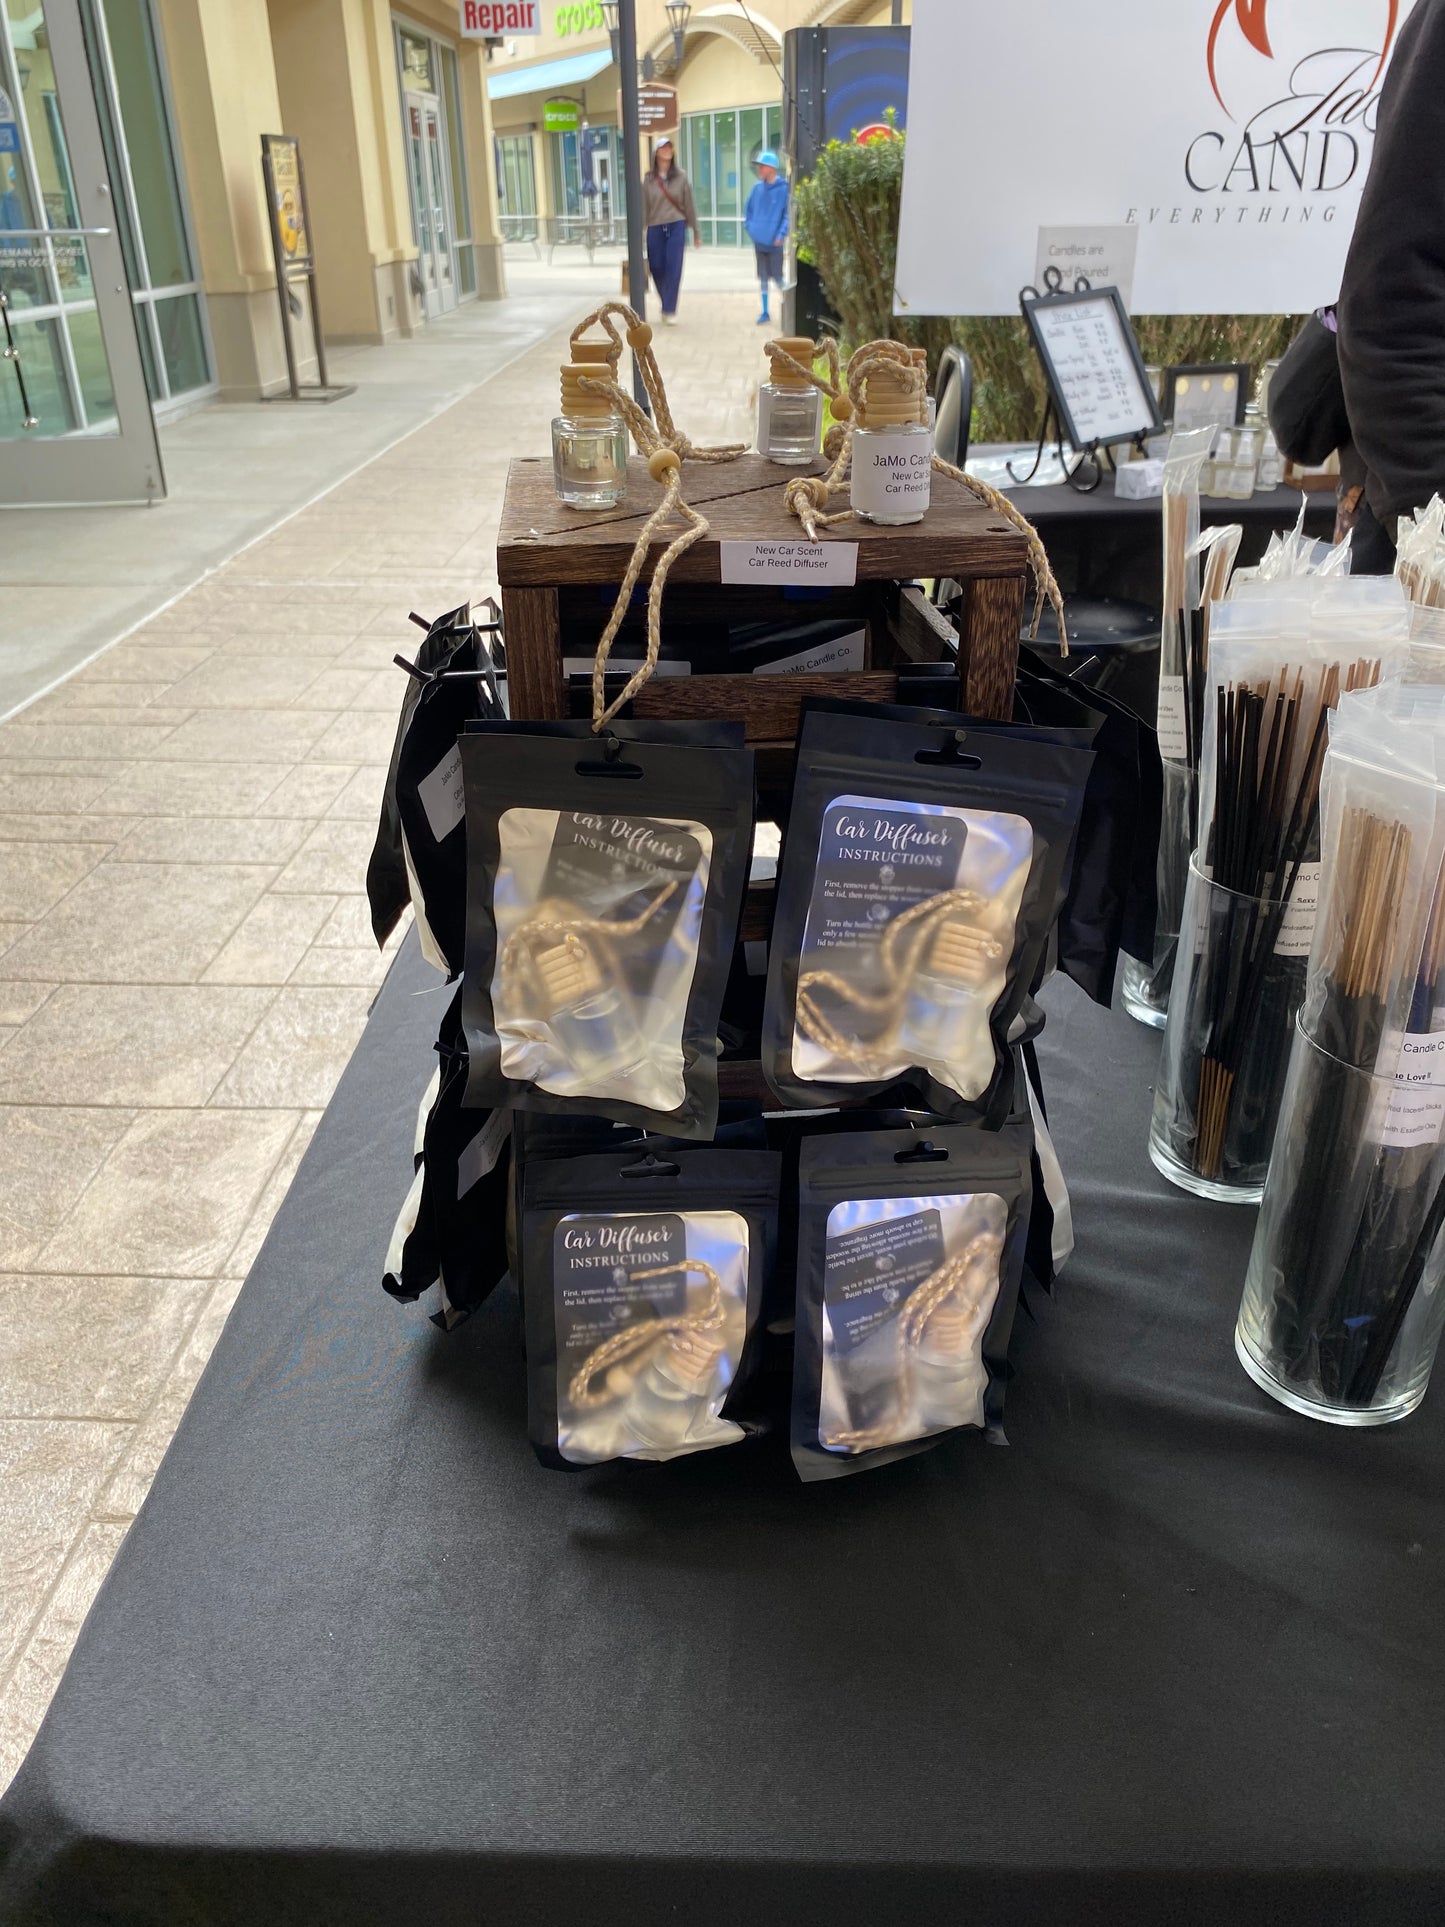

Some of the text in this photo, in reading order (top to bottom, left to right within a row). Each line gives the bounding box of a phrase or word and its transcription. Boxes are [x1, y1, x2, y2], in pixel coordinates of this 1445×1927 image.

[464, 0, 535, 33] Repair
[555, 0, 604, 37] crocs
[545, 110, 578, 122] crocs
[1185, 131, 1364, 193] CAND
[1125, 205, 1337, 224] EVERYTHING
[1048, 244, 1104, 256] Candles are
[1075, 265, 1109, 277] Poured
[873, 455, 906, 467] JaMo
[892, 472, 911, 480] New
[914, 471, 925, 479] Car
[885, 484, 901, 493] Car
[904, 483, 923, 492] Reed
[756, 546, 823, 556] New Car Scent
[749, 558, 828, 568] Car Reed Diffuser
[807, 652, 835, 670] Candle
[572, 813, 686, 863] Car Diffuser
[835, 816, 952, 850] Car Diffuser
[838, 847, 943, 867] INSTRUCTIONS
[824, 880, 841, 888] First,
[843, 882, 867, 890] remove
[869, 882, 879, 890] the
[848, 891, 864, 899] then
[826, 919, 841, 927] Turn
[843, 920, 853, 928] the
[822, 931, 837, 939] only
[1403, 1042, 1436, 1054] Candle
[905, 1222, 911, 1230] to
[913, 1219, 923, 1227] cap
[869, 1231, 884, 1239] more
[885, 1225, 904, 1235] absorb
[564, 1225, 673, 1253] Car Diffuser
[861, 1238, 886, 1250] allowing
[570, 1251, 669, 1269] INSTRUCTIONS
[826, 1250, 849, 1260] wooden
[856, 1251, 874, 1259] invert
[828, 1260, 846, 1269] bottle
[845, 1289, 861, 1299] string
[564, 1298, 574, 1306] the
